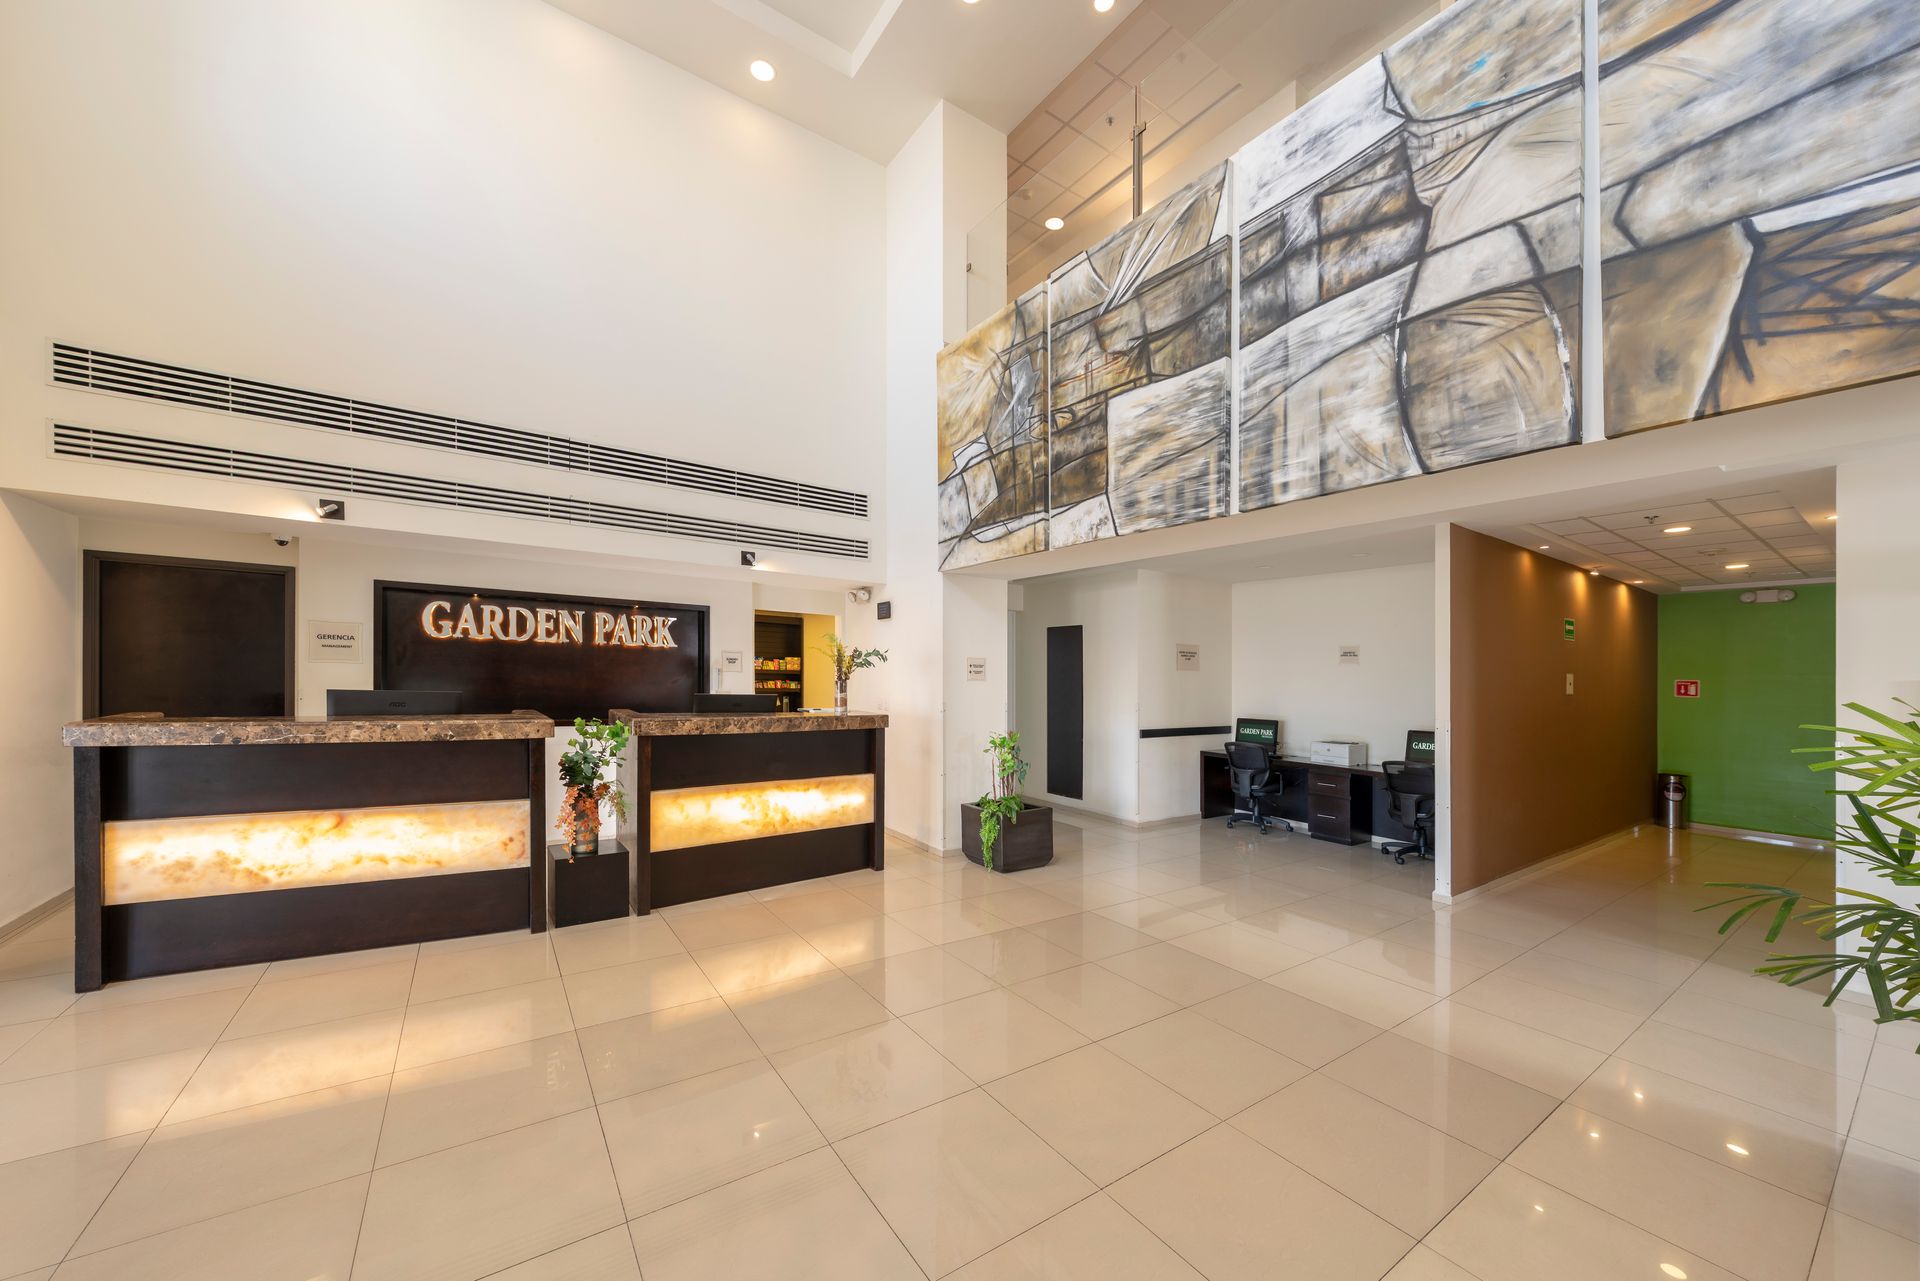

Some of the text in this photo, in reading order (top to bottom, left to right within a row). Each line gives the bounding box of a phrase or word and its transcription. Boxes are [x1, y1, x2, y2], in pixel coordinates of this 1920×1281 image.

[422, 601, 678, 648] GARDEN PARK
[316, 633, 356, 641] GERENCIA
[1240, 727, 1260, 735] GARDEN
